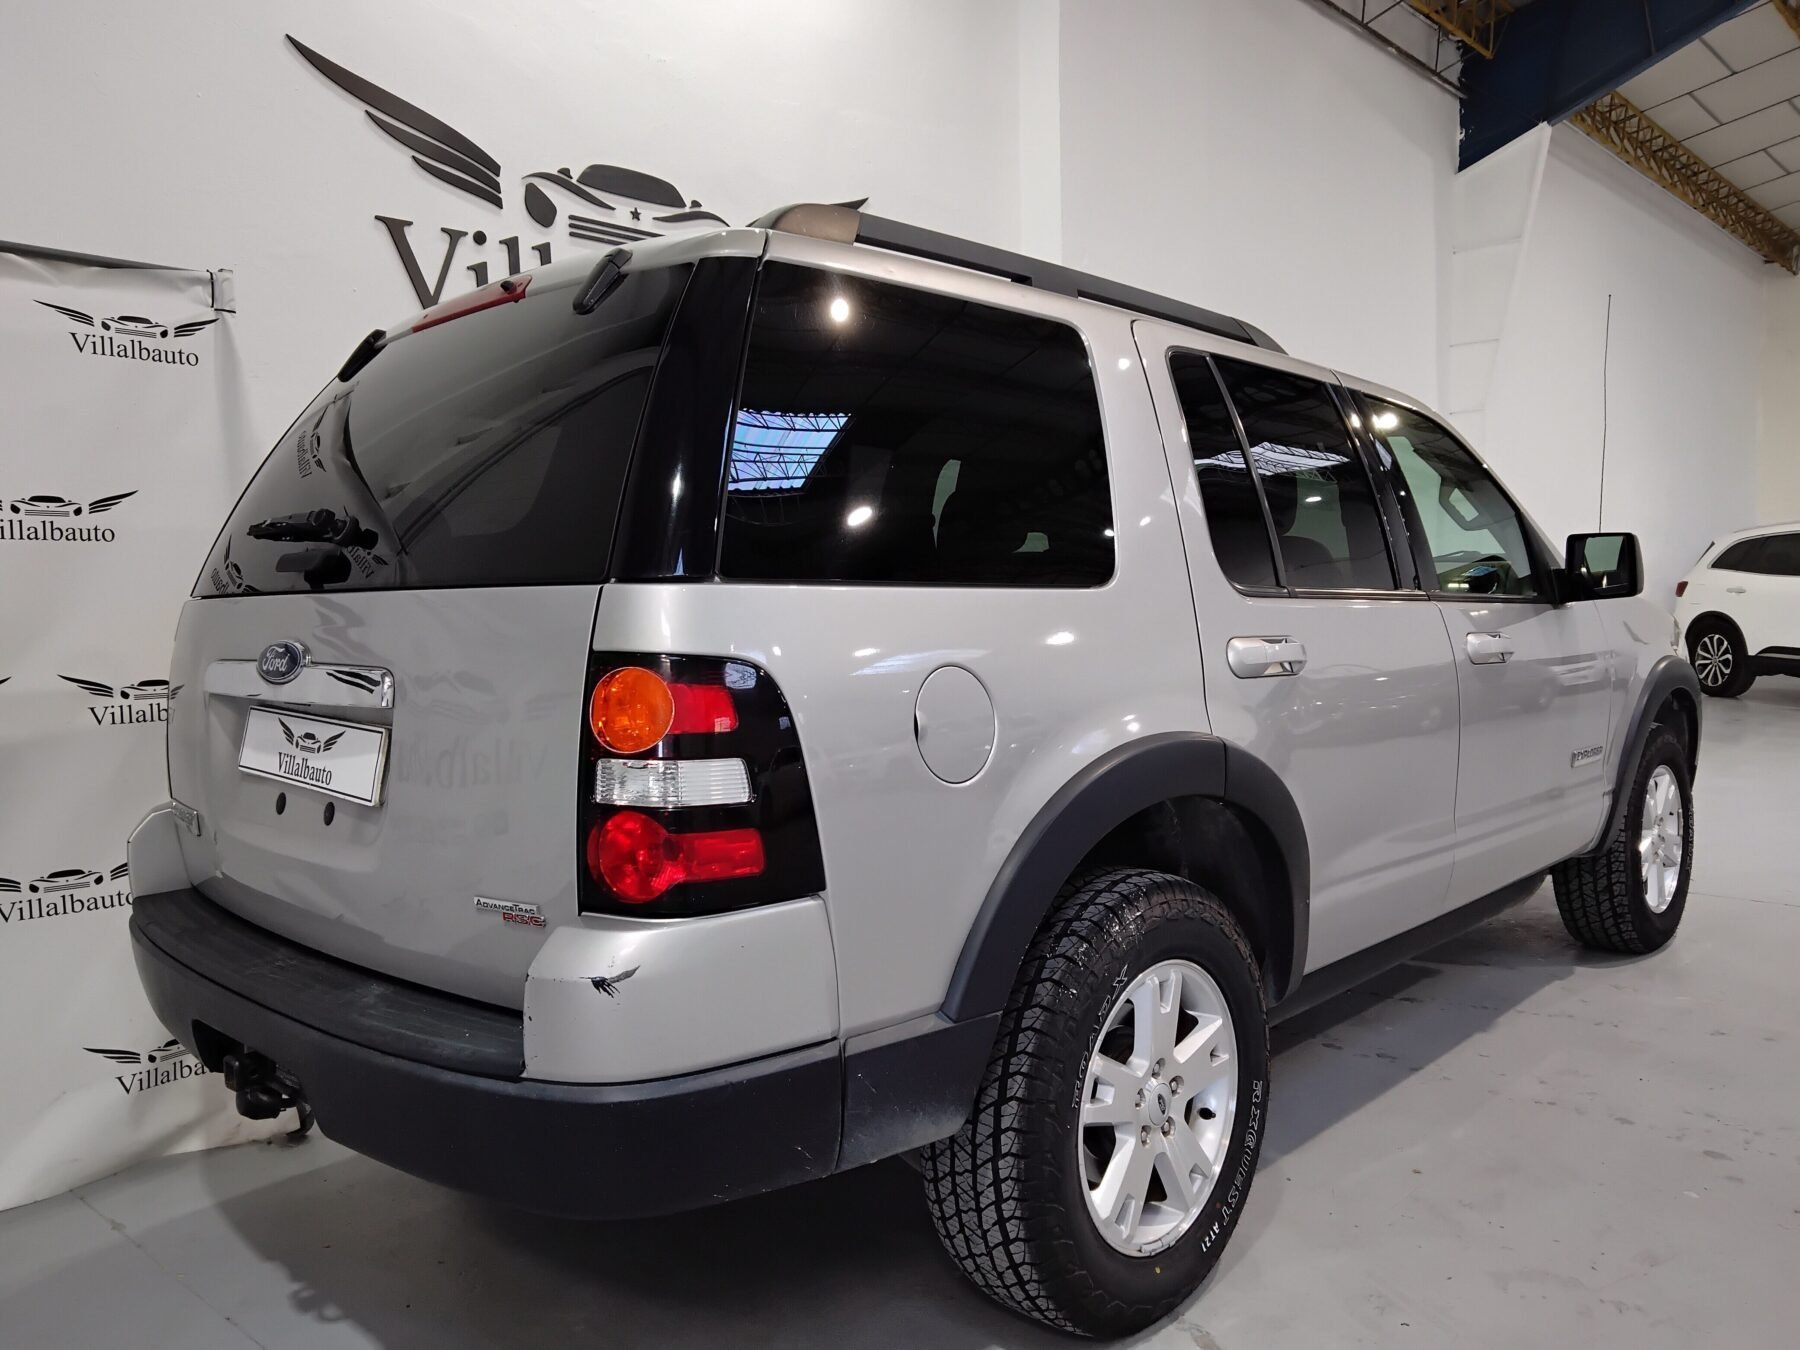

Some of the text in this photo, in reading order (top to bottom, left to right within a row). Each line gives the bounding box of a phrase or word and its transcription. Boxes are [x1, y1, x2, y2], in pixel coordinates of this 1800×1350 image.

[68, 331, 199, 367] Villalbauto
[0, 519, 115, 542] illalbauto
[262, 646, 290, 672] Ford
[87, 702, 168, 726] Villalb
[278, 751, 332, 786] Villalbauto
[502, 911, 546, 928] RSC
[115, 1060, 207, 1095] Villalba
